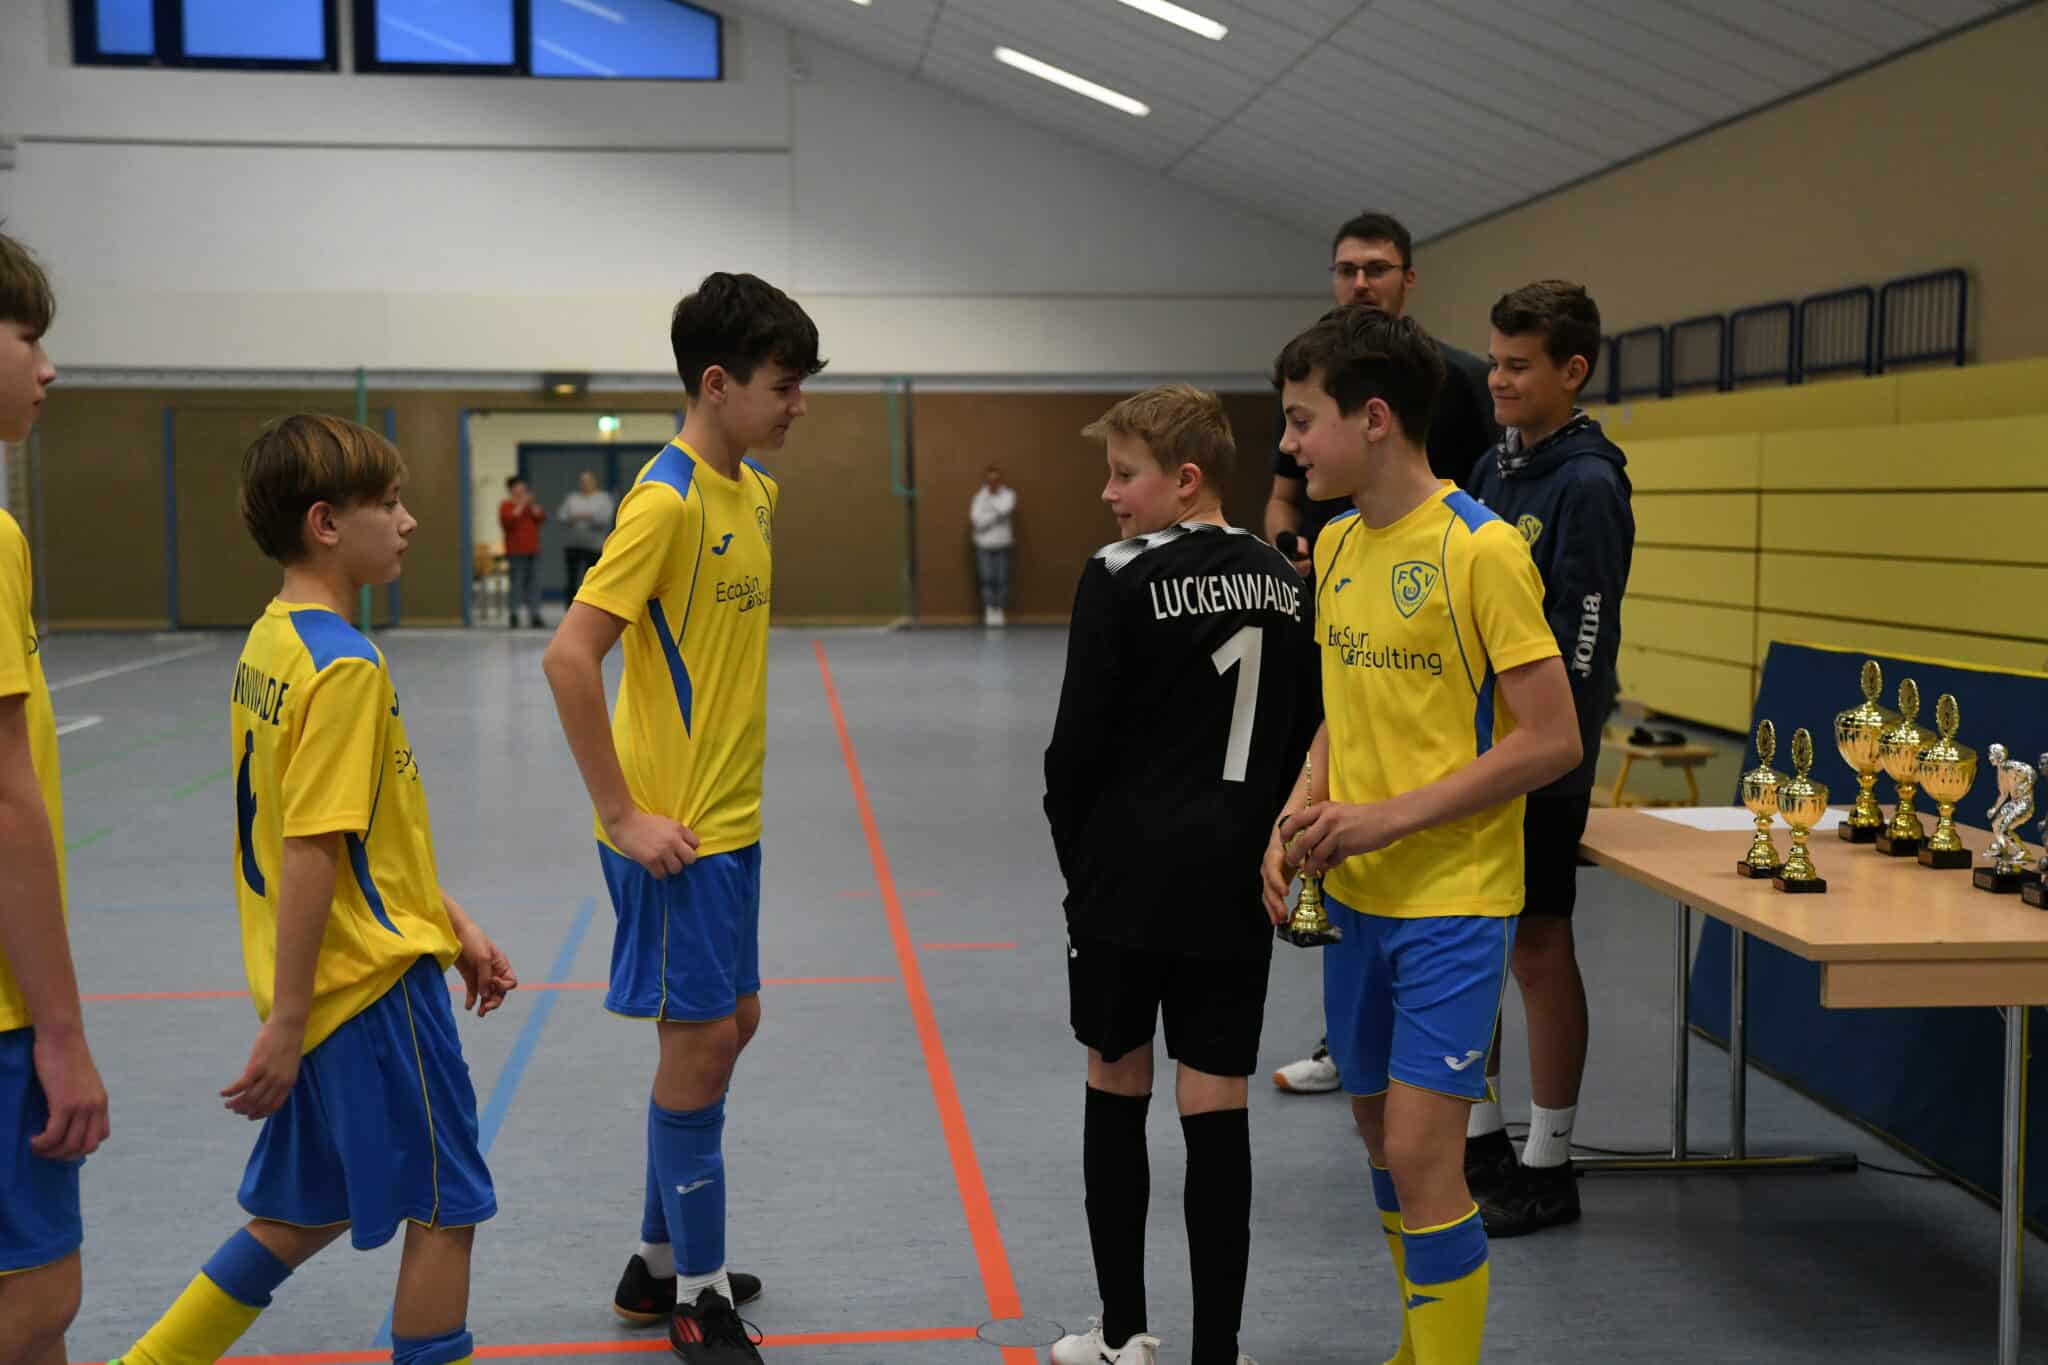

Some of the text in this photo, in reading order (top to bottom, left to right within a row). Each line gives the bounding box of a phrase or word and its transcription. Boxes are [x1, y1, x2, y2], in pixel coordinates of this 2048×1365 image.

[1150, 573, 1301, 622] LUCKENWALDE
[1397, 566, 1435, 600] FSV
[1211, 625, 1263, 782] 1
